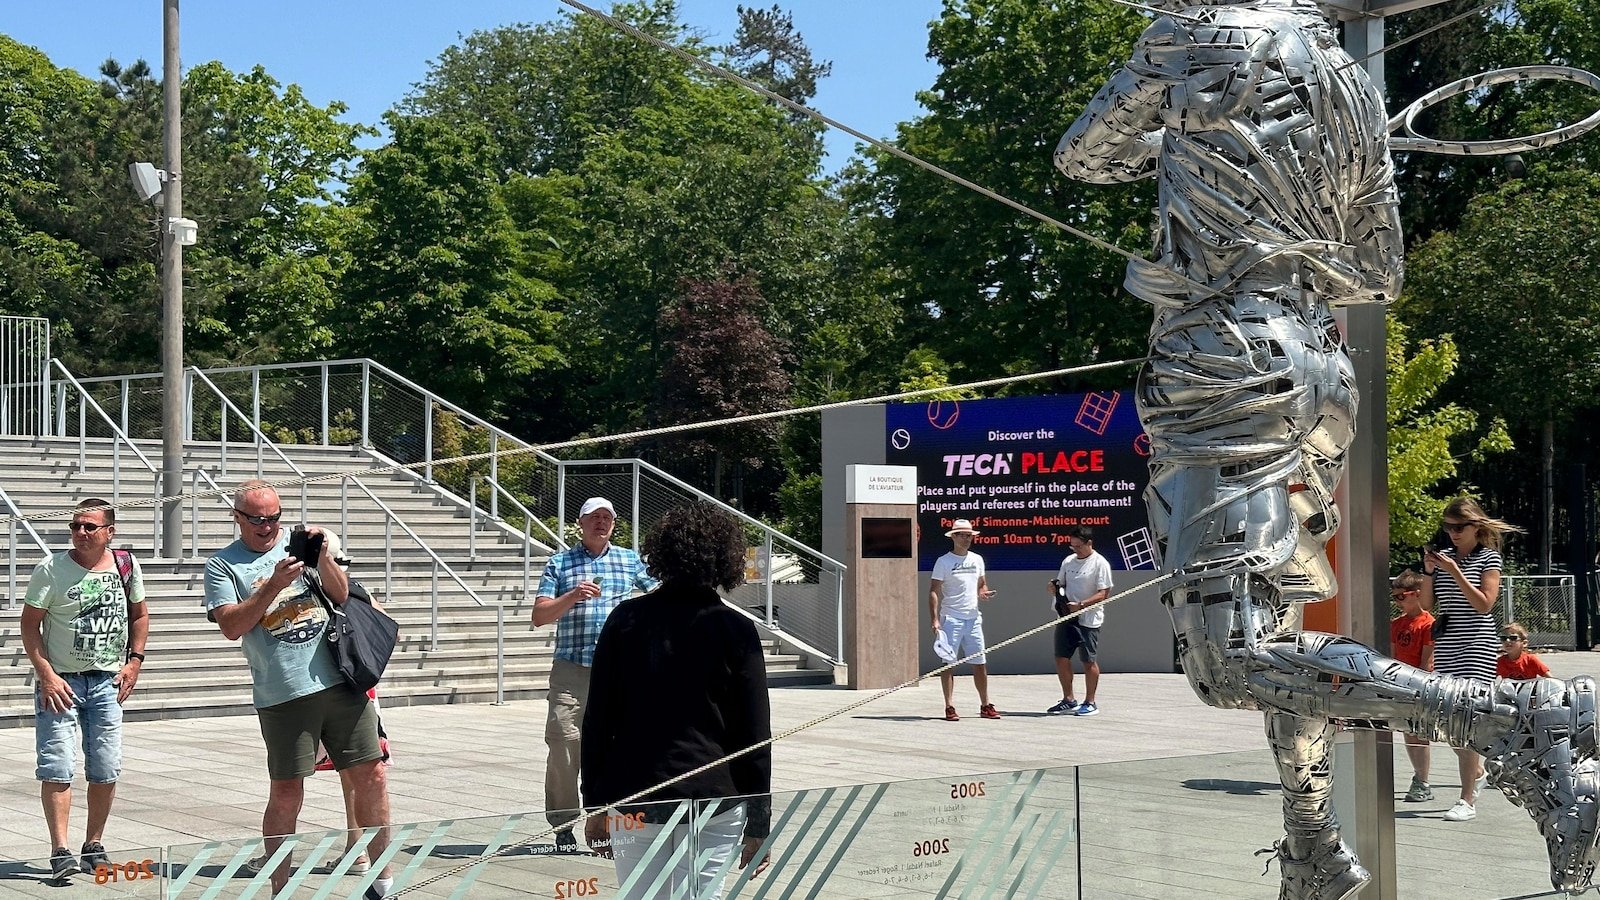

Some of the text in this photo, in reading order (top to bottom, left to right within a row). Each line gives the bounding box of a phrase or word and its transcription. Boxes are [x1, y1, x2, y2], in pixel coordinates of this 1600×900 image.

[988, 428, 1055, 441] Discover the
[1021, 450, 1104, 474] PLACE
[917, 480, 1136, 497] Place and put yourself in the place of the
[920, 496, 1132, 513] players and referees of the tournament!
[969, 516, 981, 527] of
[982, 514, 1077, 527] Simonne-Mathieu
[1080, 515, 1110, 525] court
[974, 534, 1000, 544] From
[1003, 533, 1033, 544] 10am
[1035, 534, 1048, 543] to
